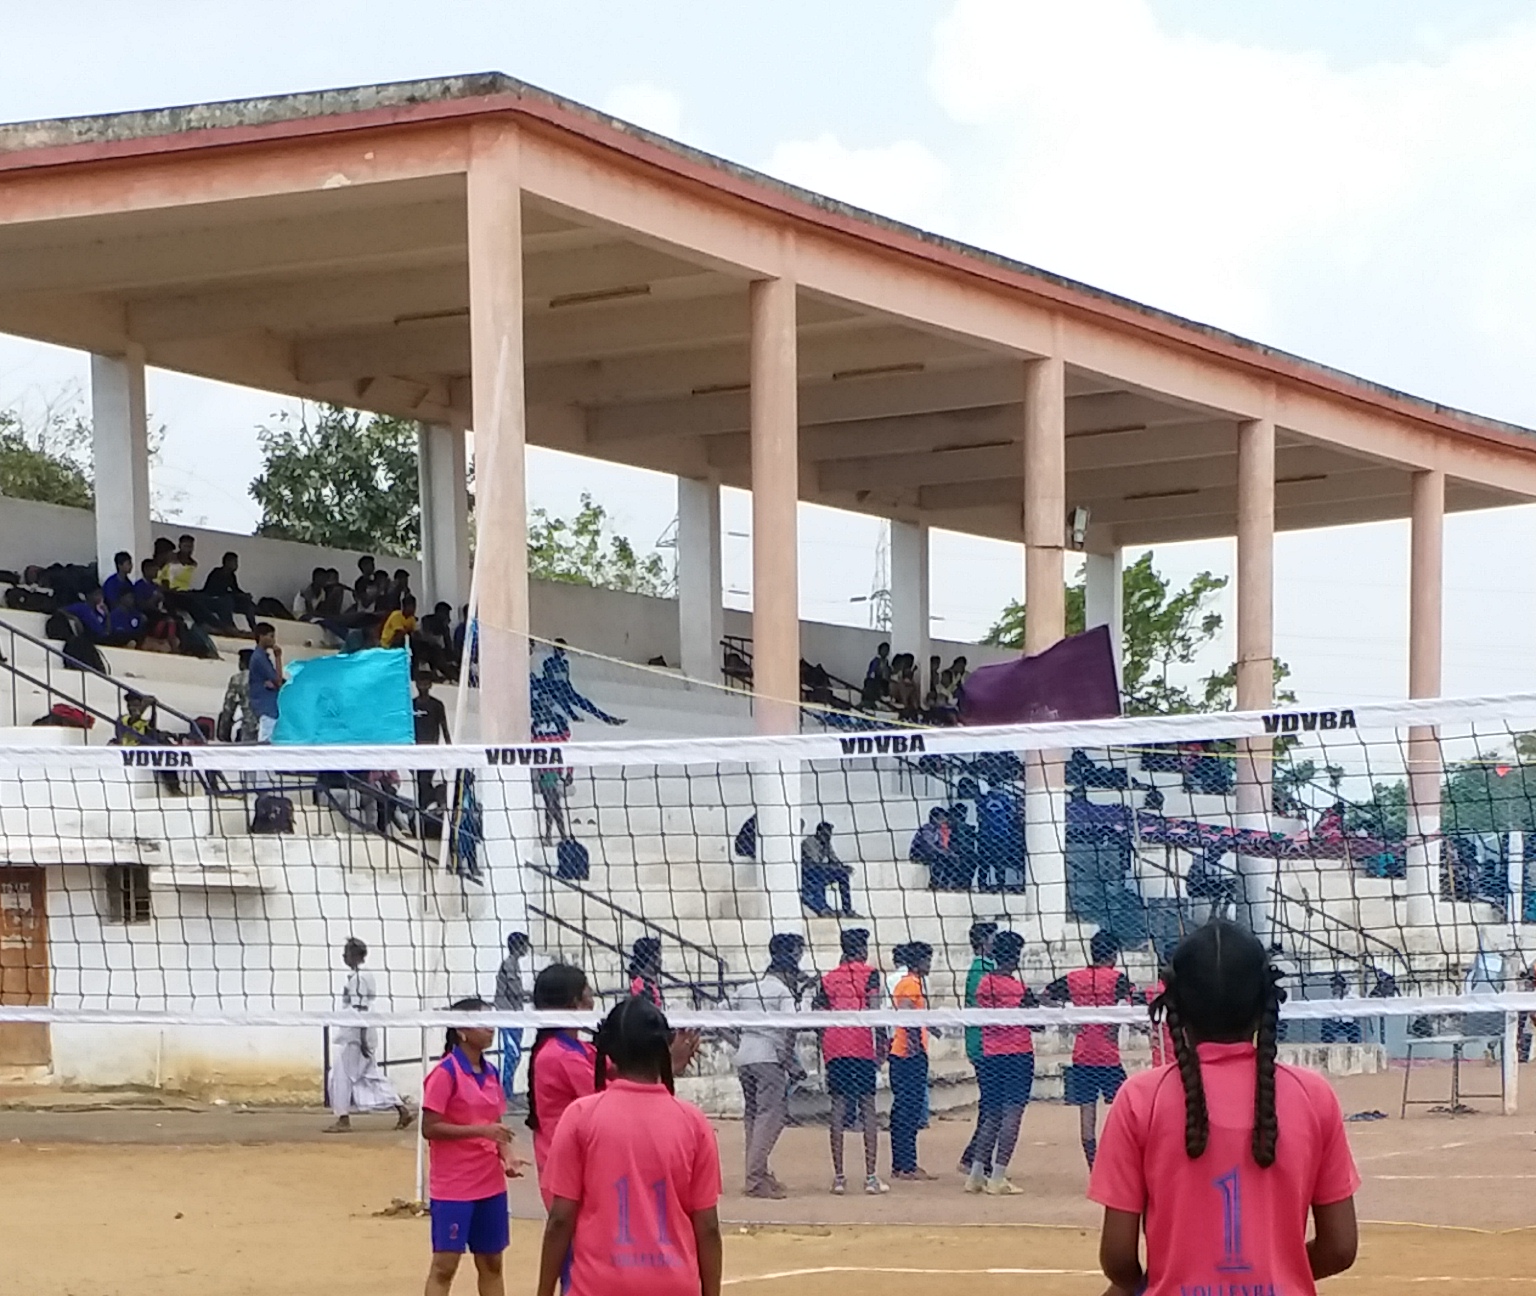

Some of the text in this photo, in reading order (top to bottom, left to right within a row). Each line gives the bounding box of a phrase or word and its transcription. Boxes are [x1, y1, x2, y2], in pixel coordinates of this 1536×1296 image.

[1261, 709, 1357, 734] VDVBA
[484, 747, 564, 765] VDVBA
[839, 734, 926, 755] VDVBA
[120, 749, 194, 767] VDVBA
[613, 1174, 673, 1246] 11
[1212, 1165, 1252, 1272] 1
